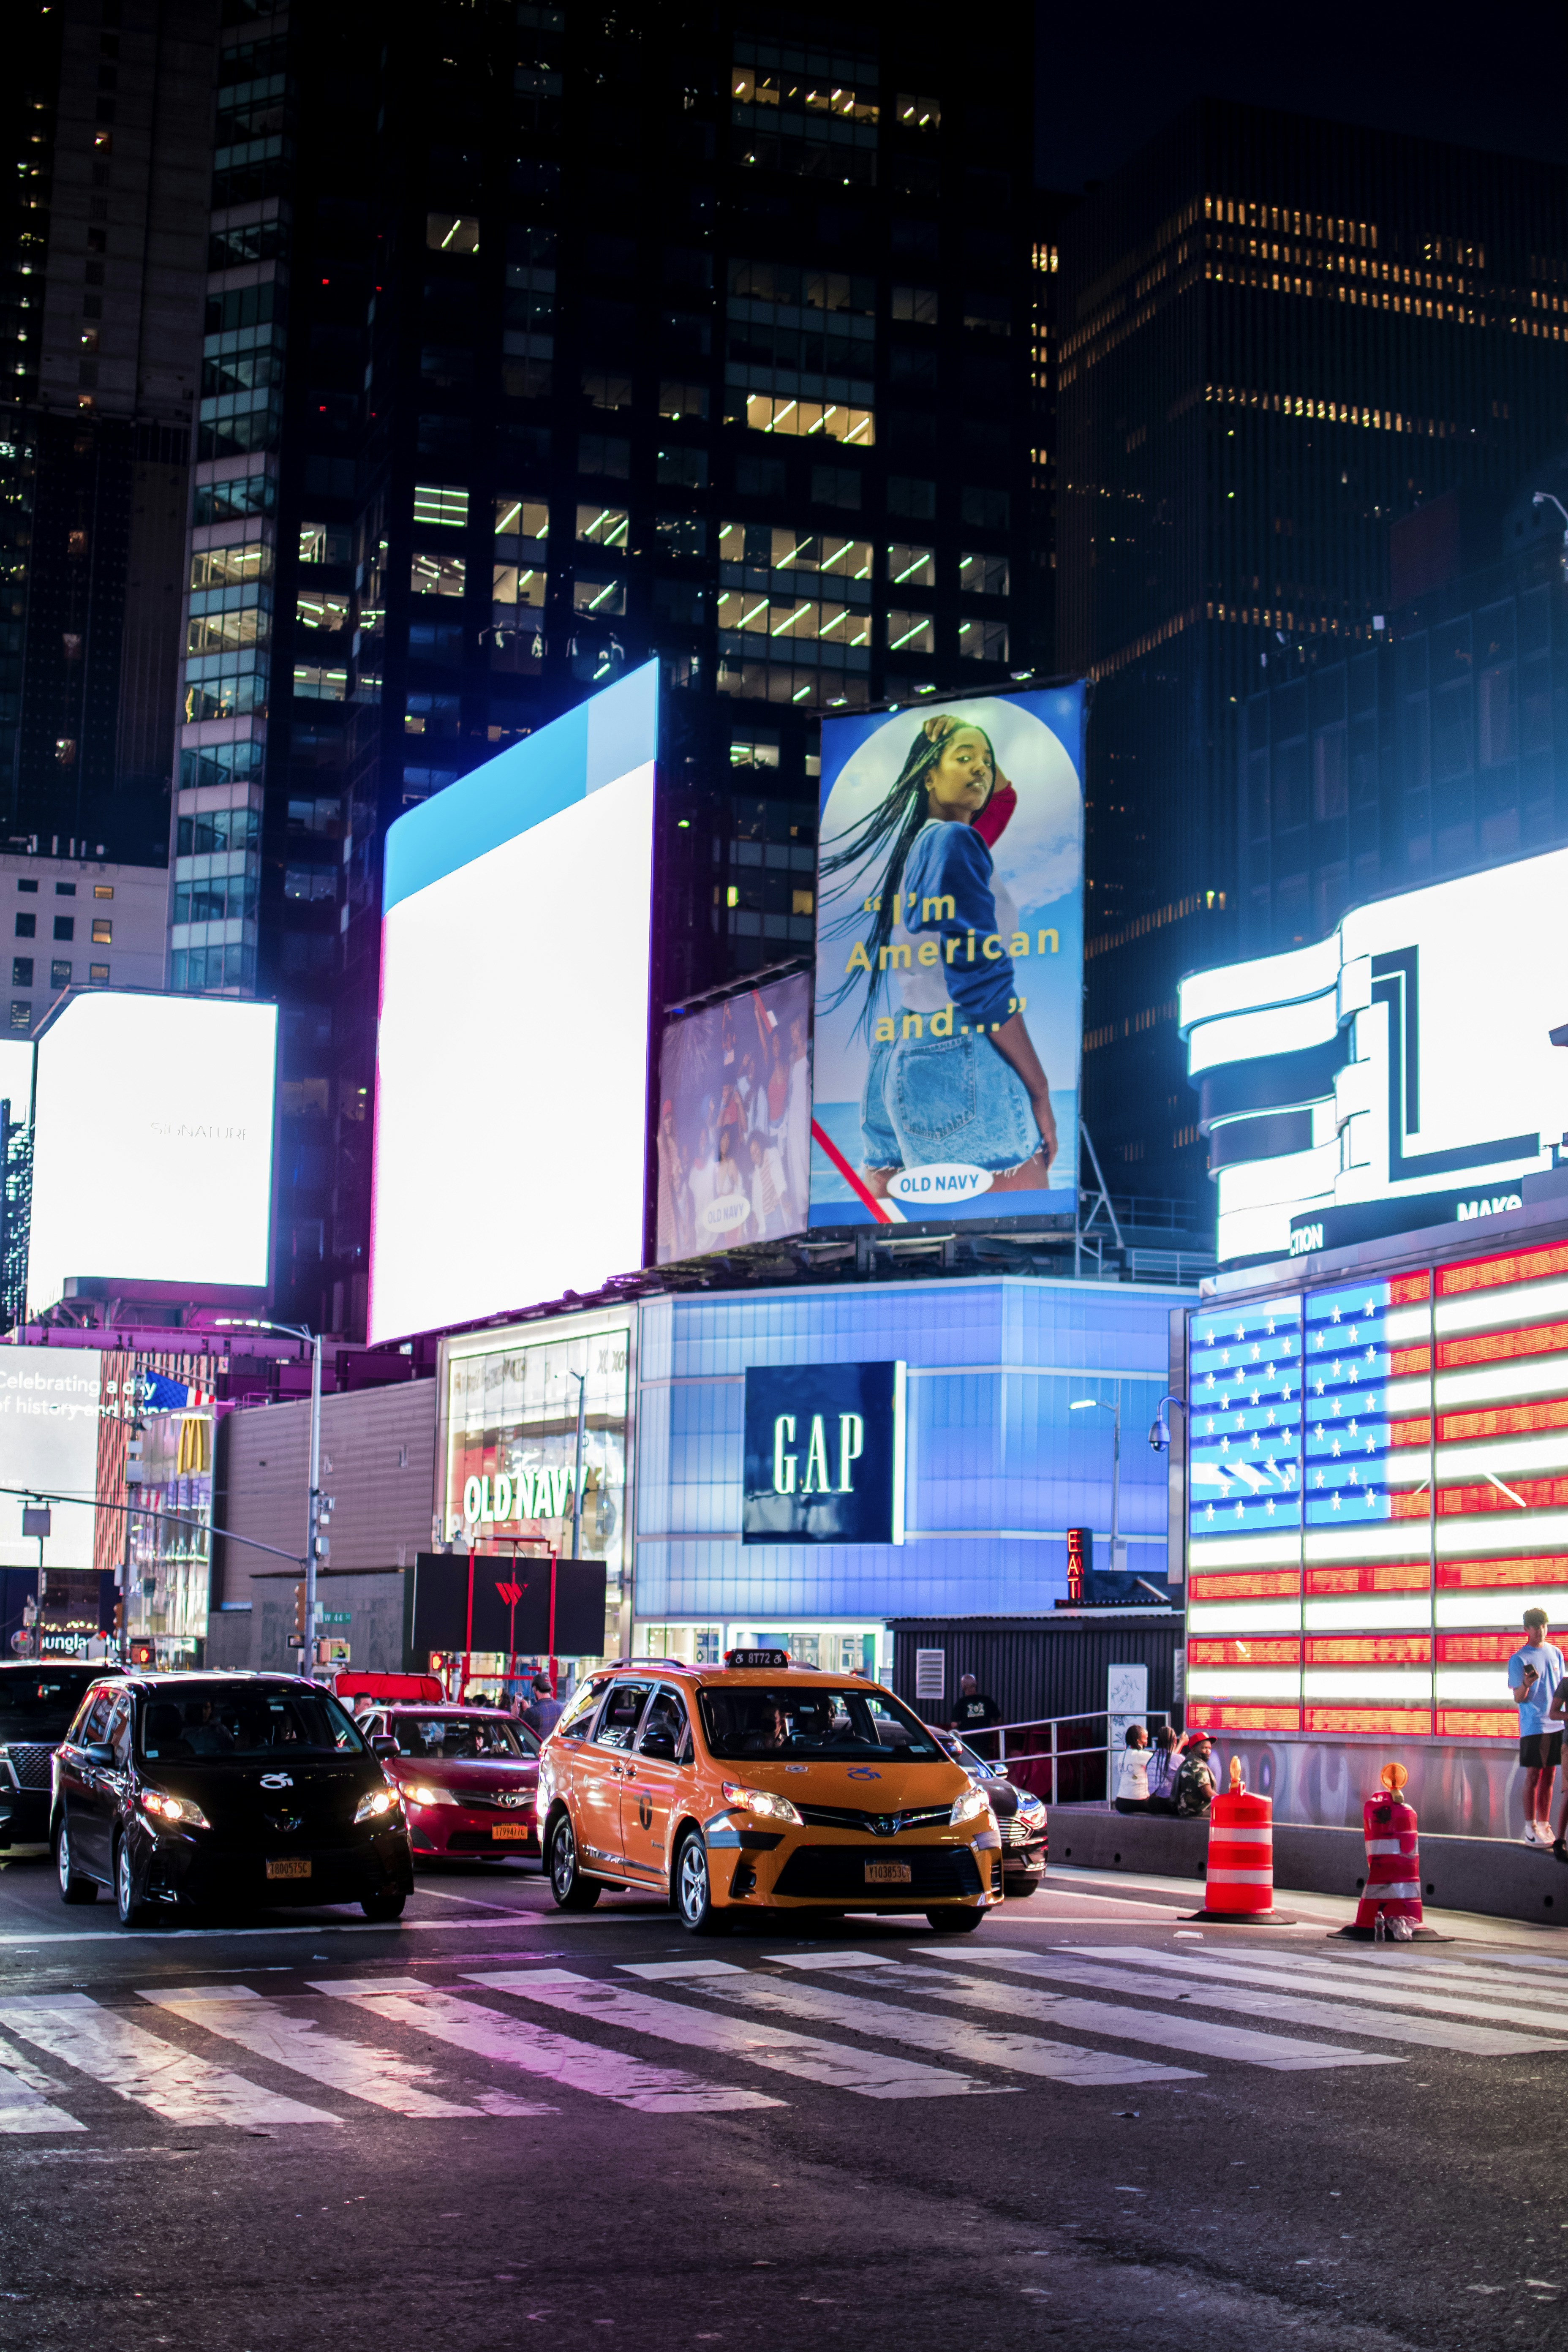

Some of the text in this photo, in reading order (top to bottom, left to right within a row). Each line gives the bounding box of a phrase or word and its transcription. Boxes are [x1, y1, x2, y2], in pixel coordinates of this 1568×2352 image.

[845, 928, 1059, 972] American
[900, 1174, 980, 1193] OLD NAVY
[708, 1203, 744, 1224] OLD NAVY
[106, 1380, 118, 1394] a
[16, 1396, 77, 1420] history
[773, 1413, 864, 1494] GAP
[463, 1474, 513, 1524] OLD
[1067, 1530, 1080, 1599] EAT
[324, 1614, 331, 1622] W
[334, 1614, 343, 1622] 44
[748, 1652, 770, 1664] 8T72
[496, 1827, 525, 1837] T799477C
[271, 1862, 308, 1875] T800575C
[869, 1866, 906, 1879] Y103853C
